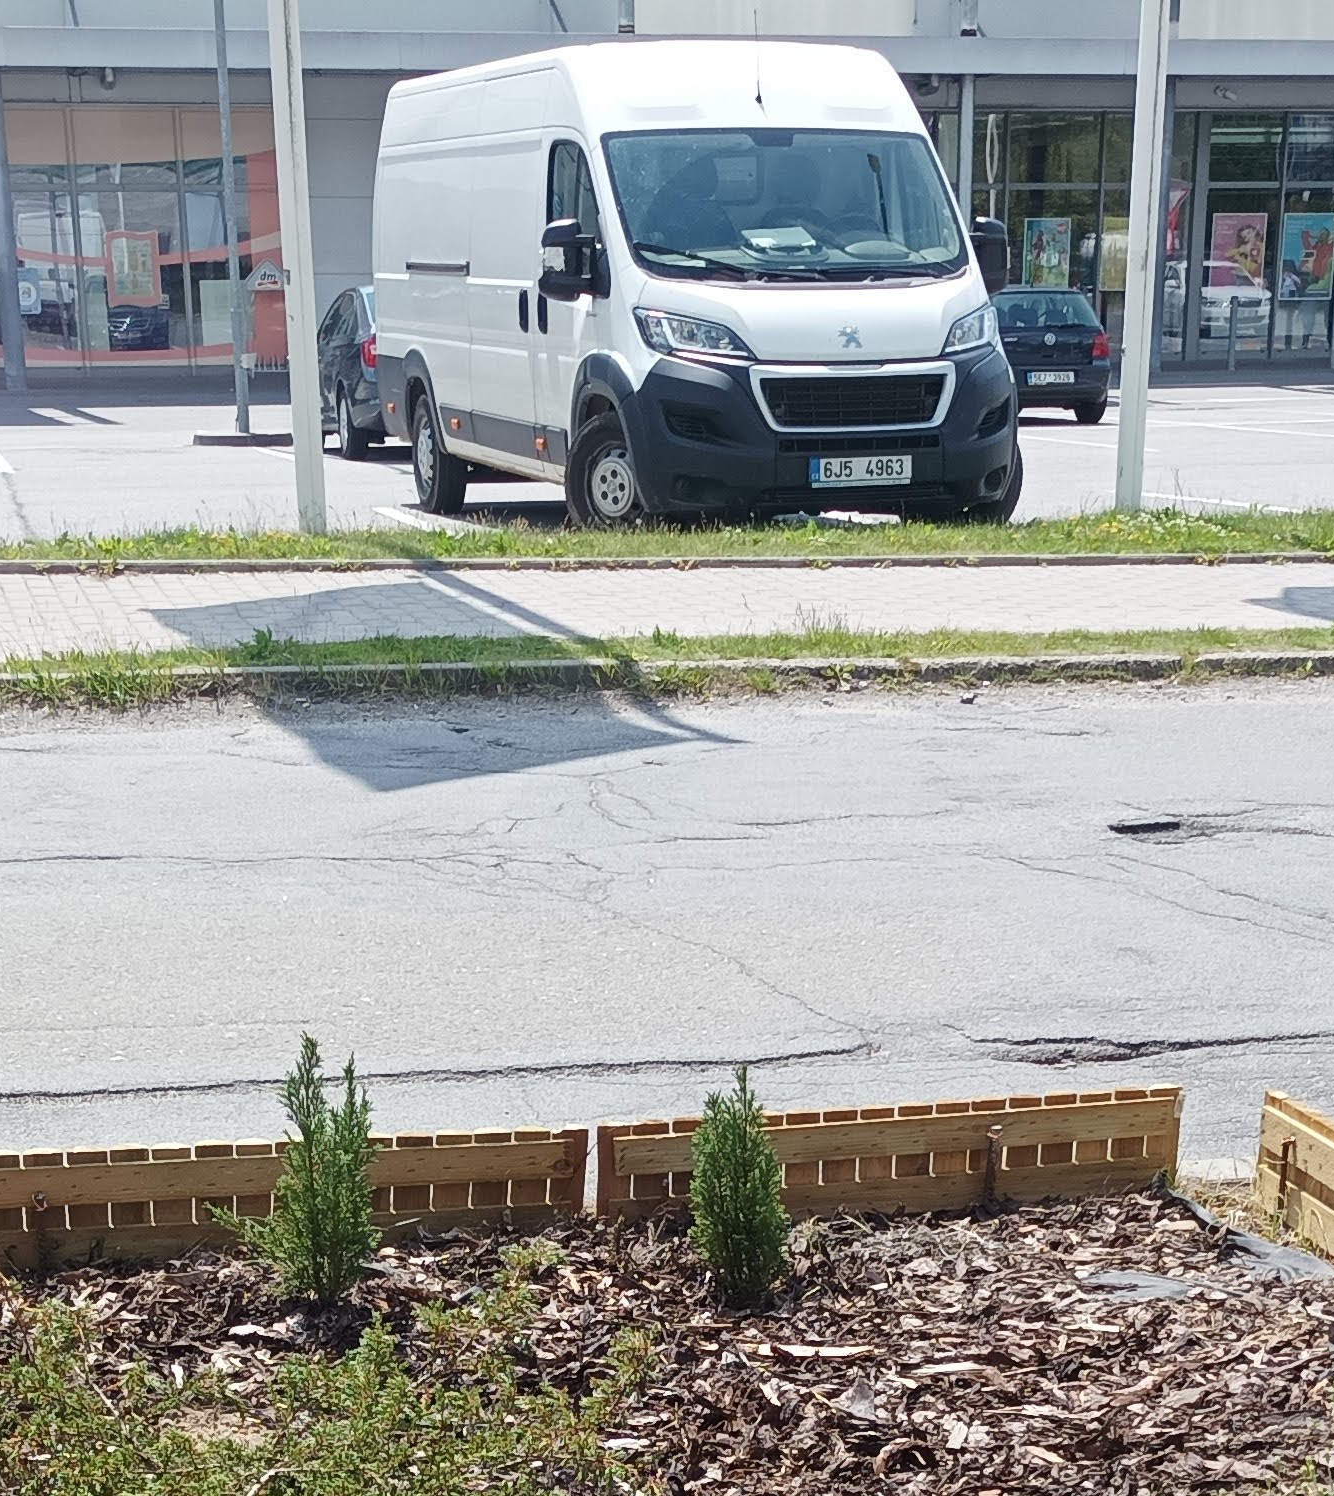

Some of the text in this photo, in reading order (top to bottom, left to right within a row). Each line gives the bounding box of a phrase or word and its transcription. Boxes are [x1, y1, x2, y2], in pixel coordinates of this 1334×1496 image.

[259, 271, 277, 282] dm
[823, 459, 904, 478] 6J5 4963
